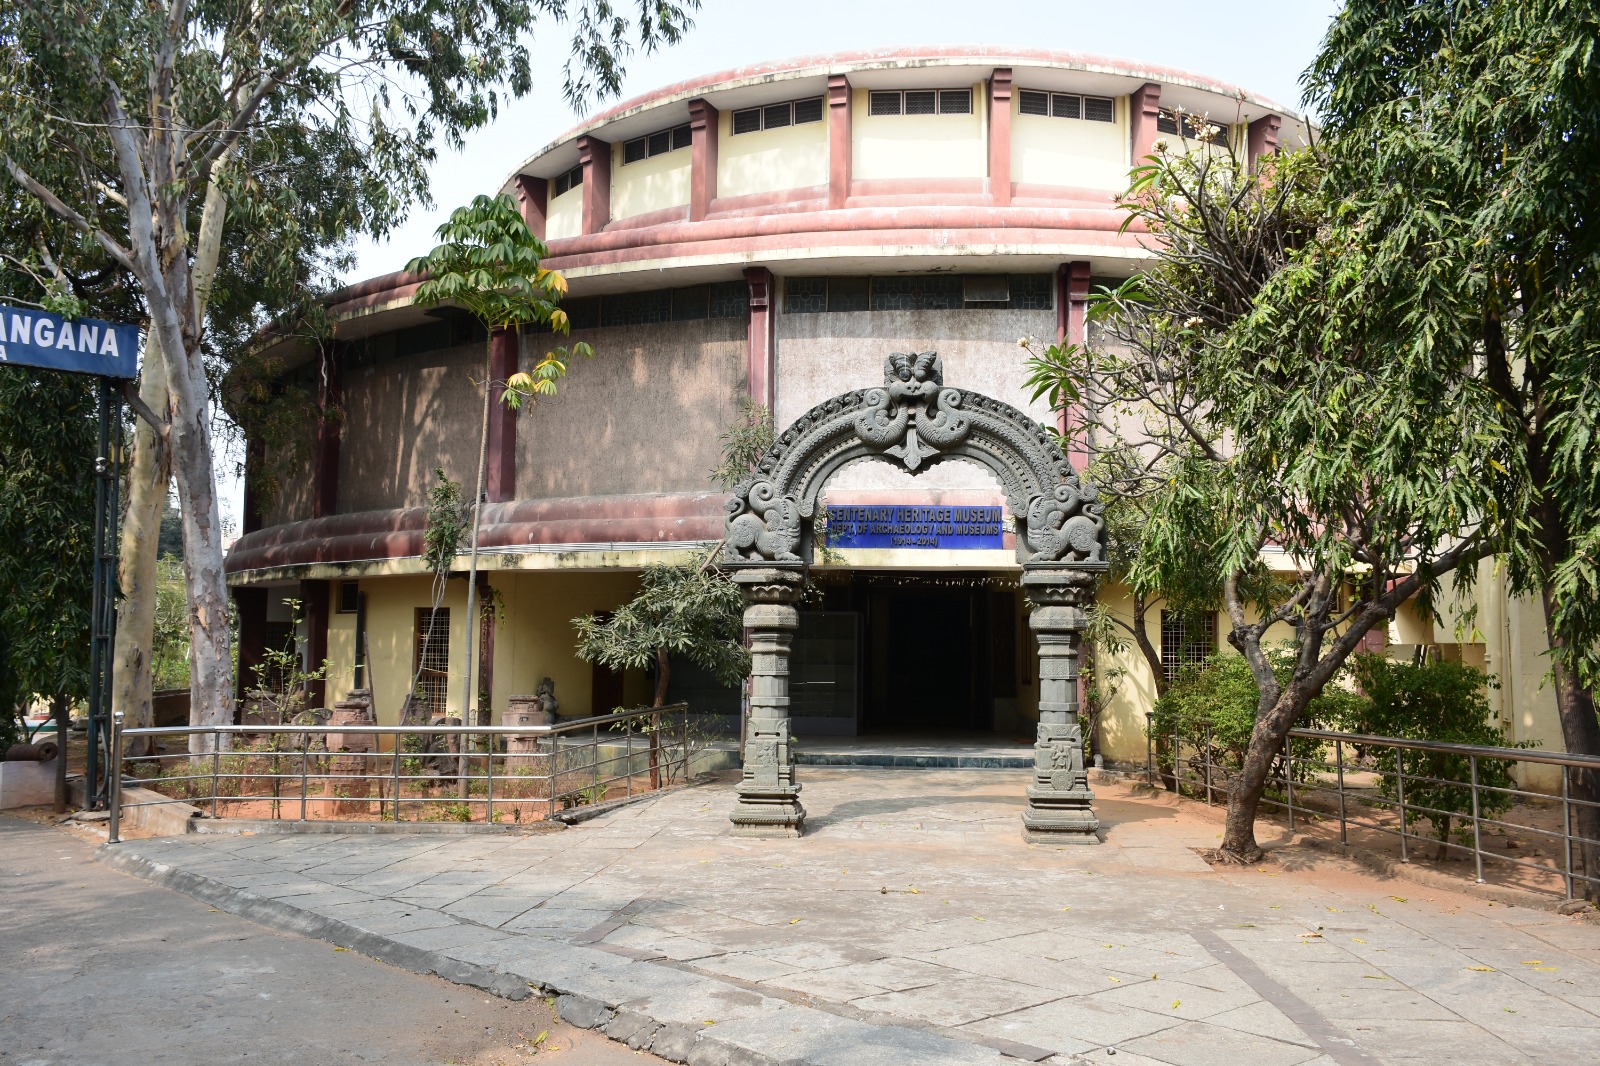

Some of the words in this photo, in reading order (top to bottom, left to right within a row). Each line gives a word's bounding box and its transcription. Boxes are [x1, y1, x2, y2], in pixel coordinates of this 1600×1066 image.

[829, 508, 894, 522] CENTENARY
[897, 508, 951, 523] HERITAGE
[954, 508, 1001, 523] MUSEUM
[857, 524, 868, 535] OF
[870, 524, 934, 535] ARCHAEOLOGY
[936, 524, 954, 536] AND
[956, 524, 999, 536] MUSEUMS
